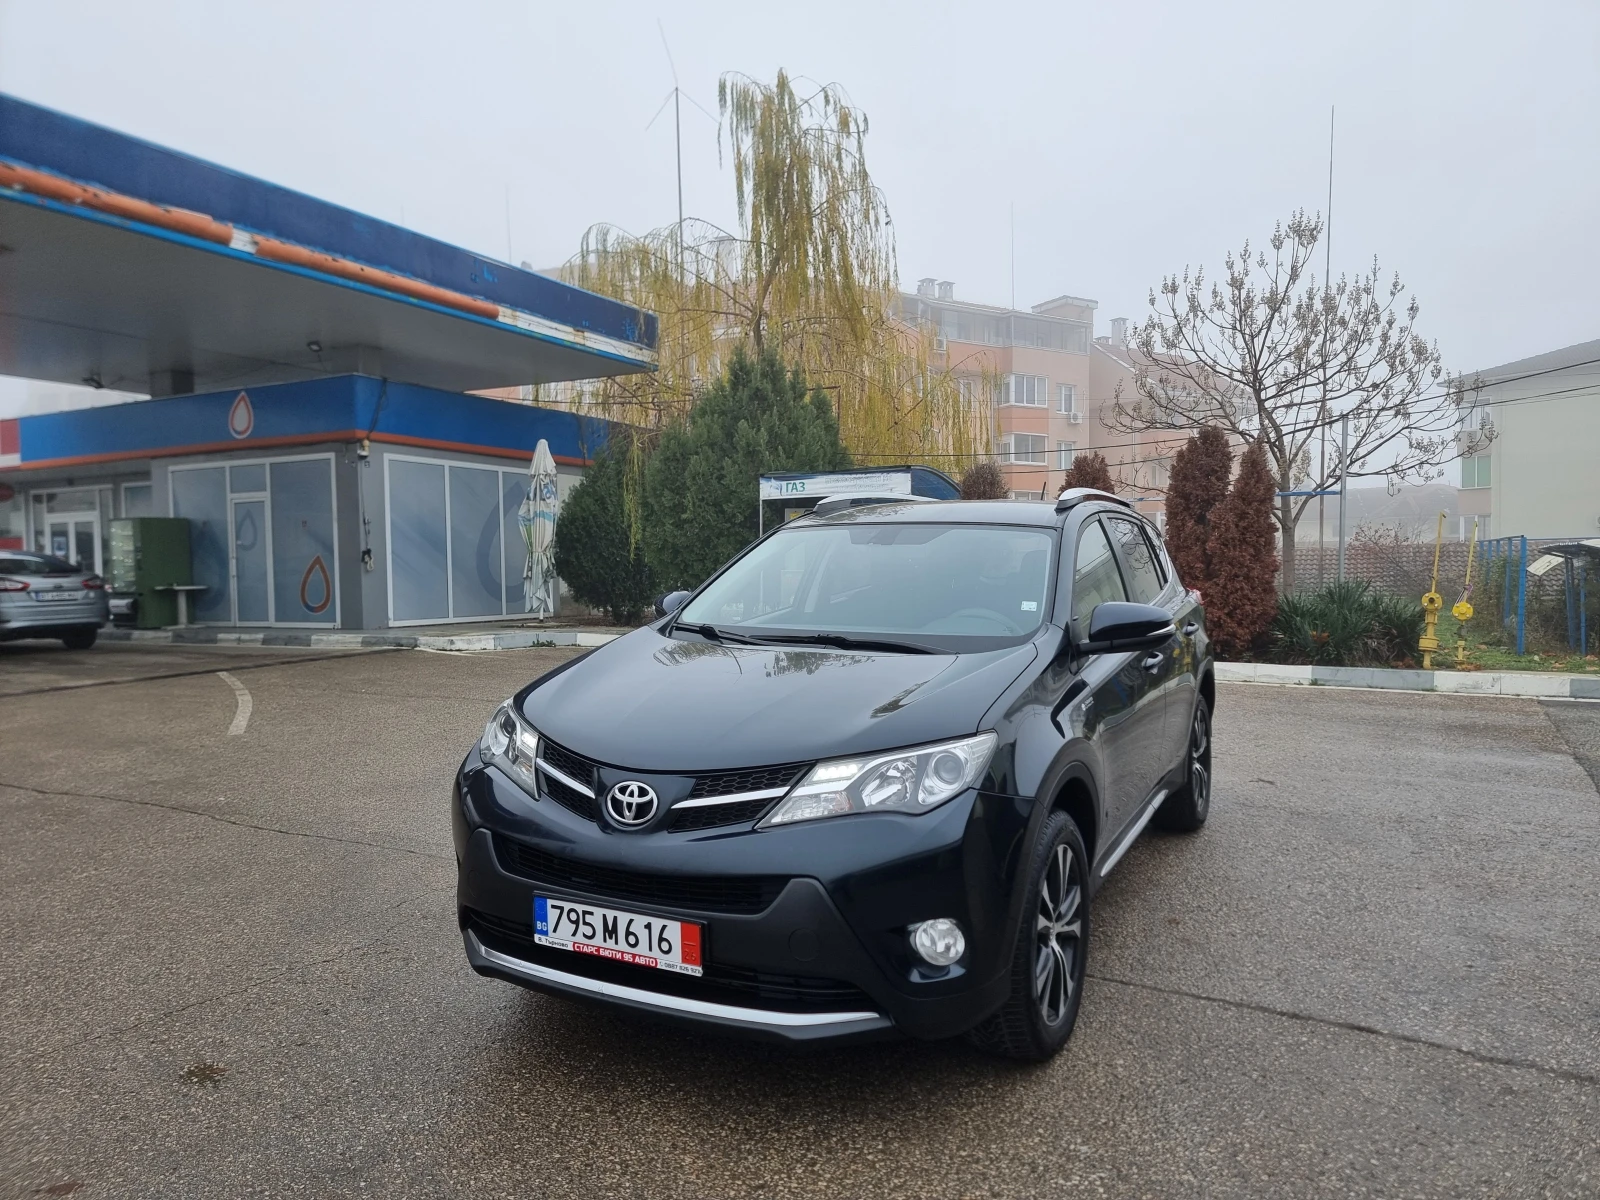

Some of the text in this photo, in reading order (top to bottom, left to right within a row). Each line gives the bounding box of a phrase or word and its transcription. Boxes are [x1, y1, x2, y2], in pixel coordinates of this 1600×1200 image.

[785, 481, 806, 493] ГАЗ
[536, 920, 548, 931] BG
[574, 942, 599, 955] СТАРС
[599, 948, 622, 960] БЮТИ
[623, 953, 633, 962] 95
[634, 955, 656, 967] АВТО
[684, 949, 697, 962] 26
